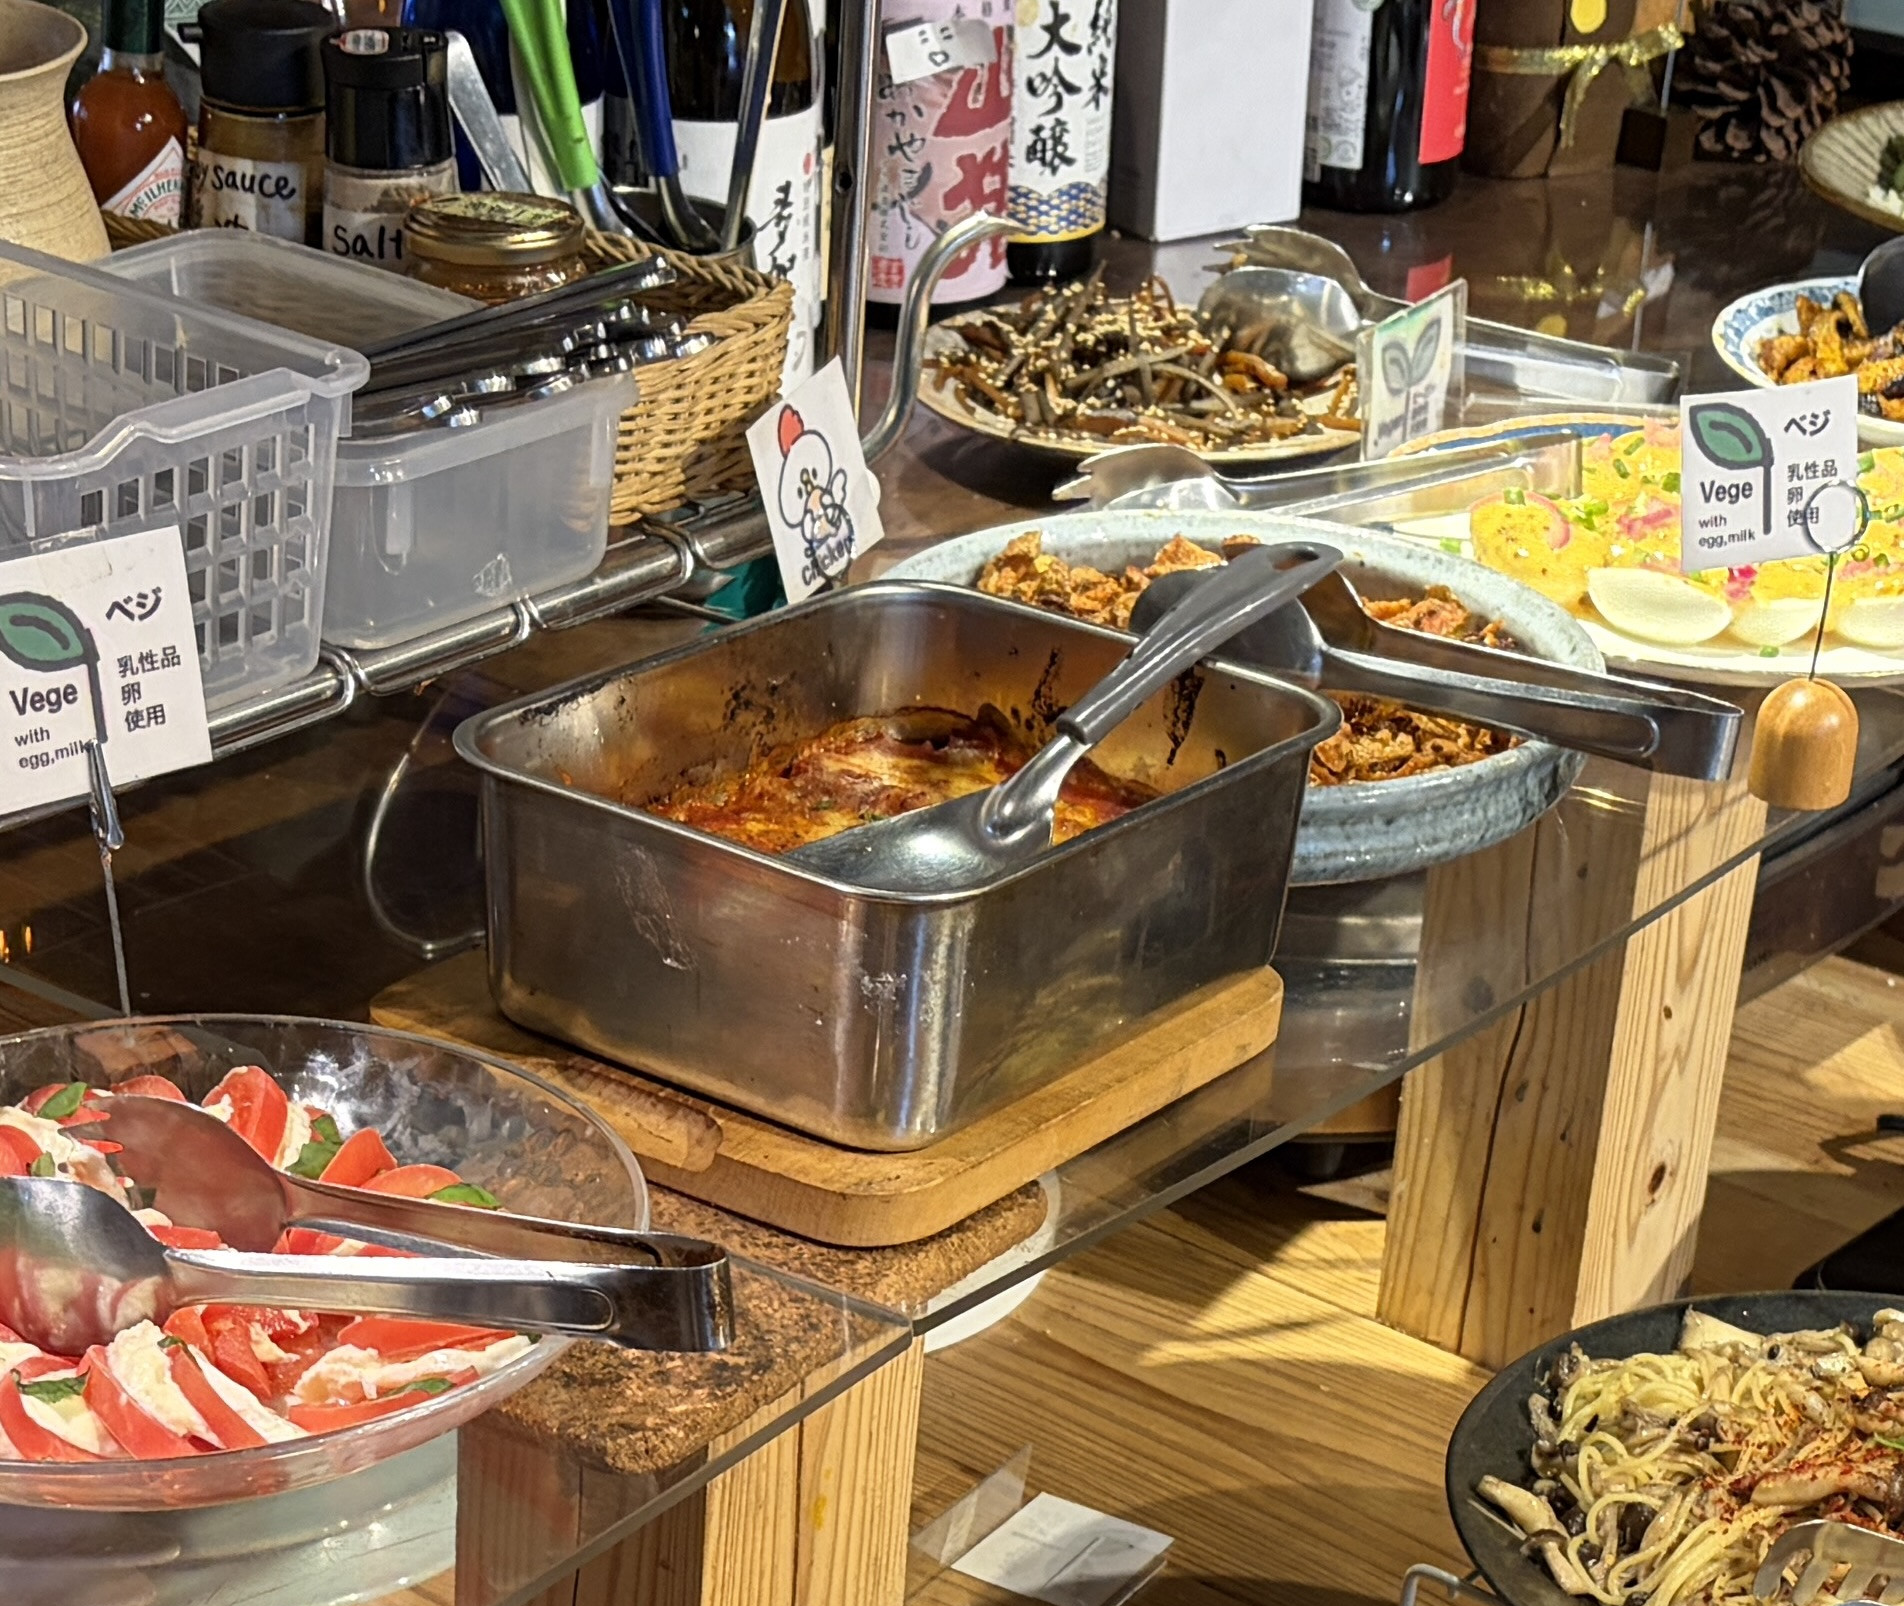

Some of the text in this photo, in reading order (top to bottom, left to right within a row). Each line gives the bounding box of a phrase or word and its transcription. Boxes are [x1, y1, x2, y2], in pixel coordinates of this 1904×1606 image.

[211, 167, 296, 201] sauce
[333, 223, 403, 260] Salt
[1783, 408, 1832, 437] ベジ
[1787, 459, 1838, 482] 乳性品
[1699, 480, 1754, 505] Vege
[1787, 486, 1804, 505] 卵
[1698, 514, 1728, 530] with
[1698, 529, 1756, 549] egg,milk
[104, 586, 163, 622] ベジ
[116, 645, 182, 679] 乳性品
[8, 683, 79, 717] Vege
[120, 682, 143, 707] 卵
[124, 703, 167, 733] 使用
[14, 726, 51, 748] with
